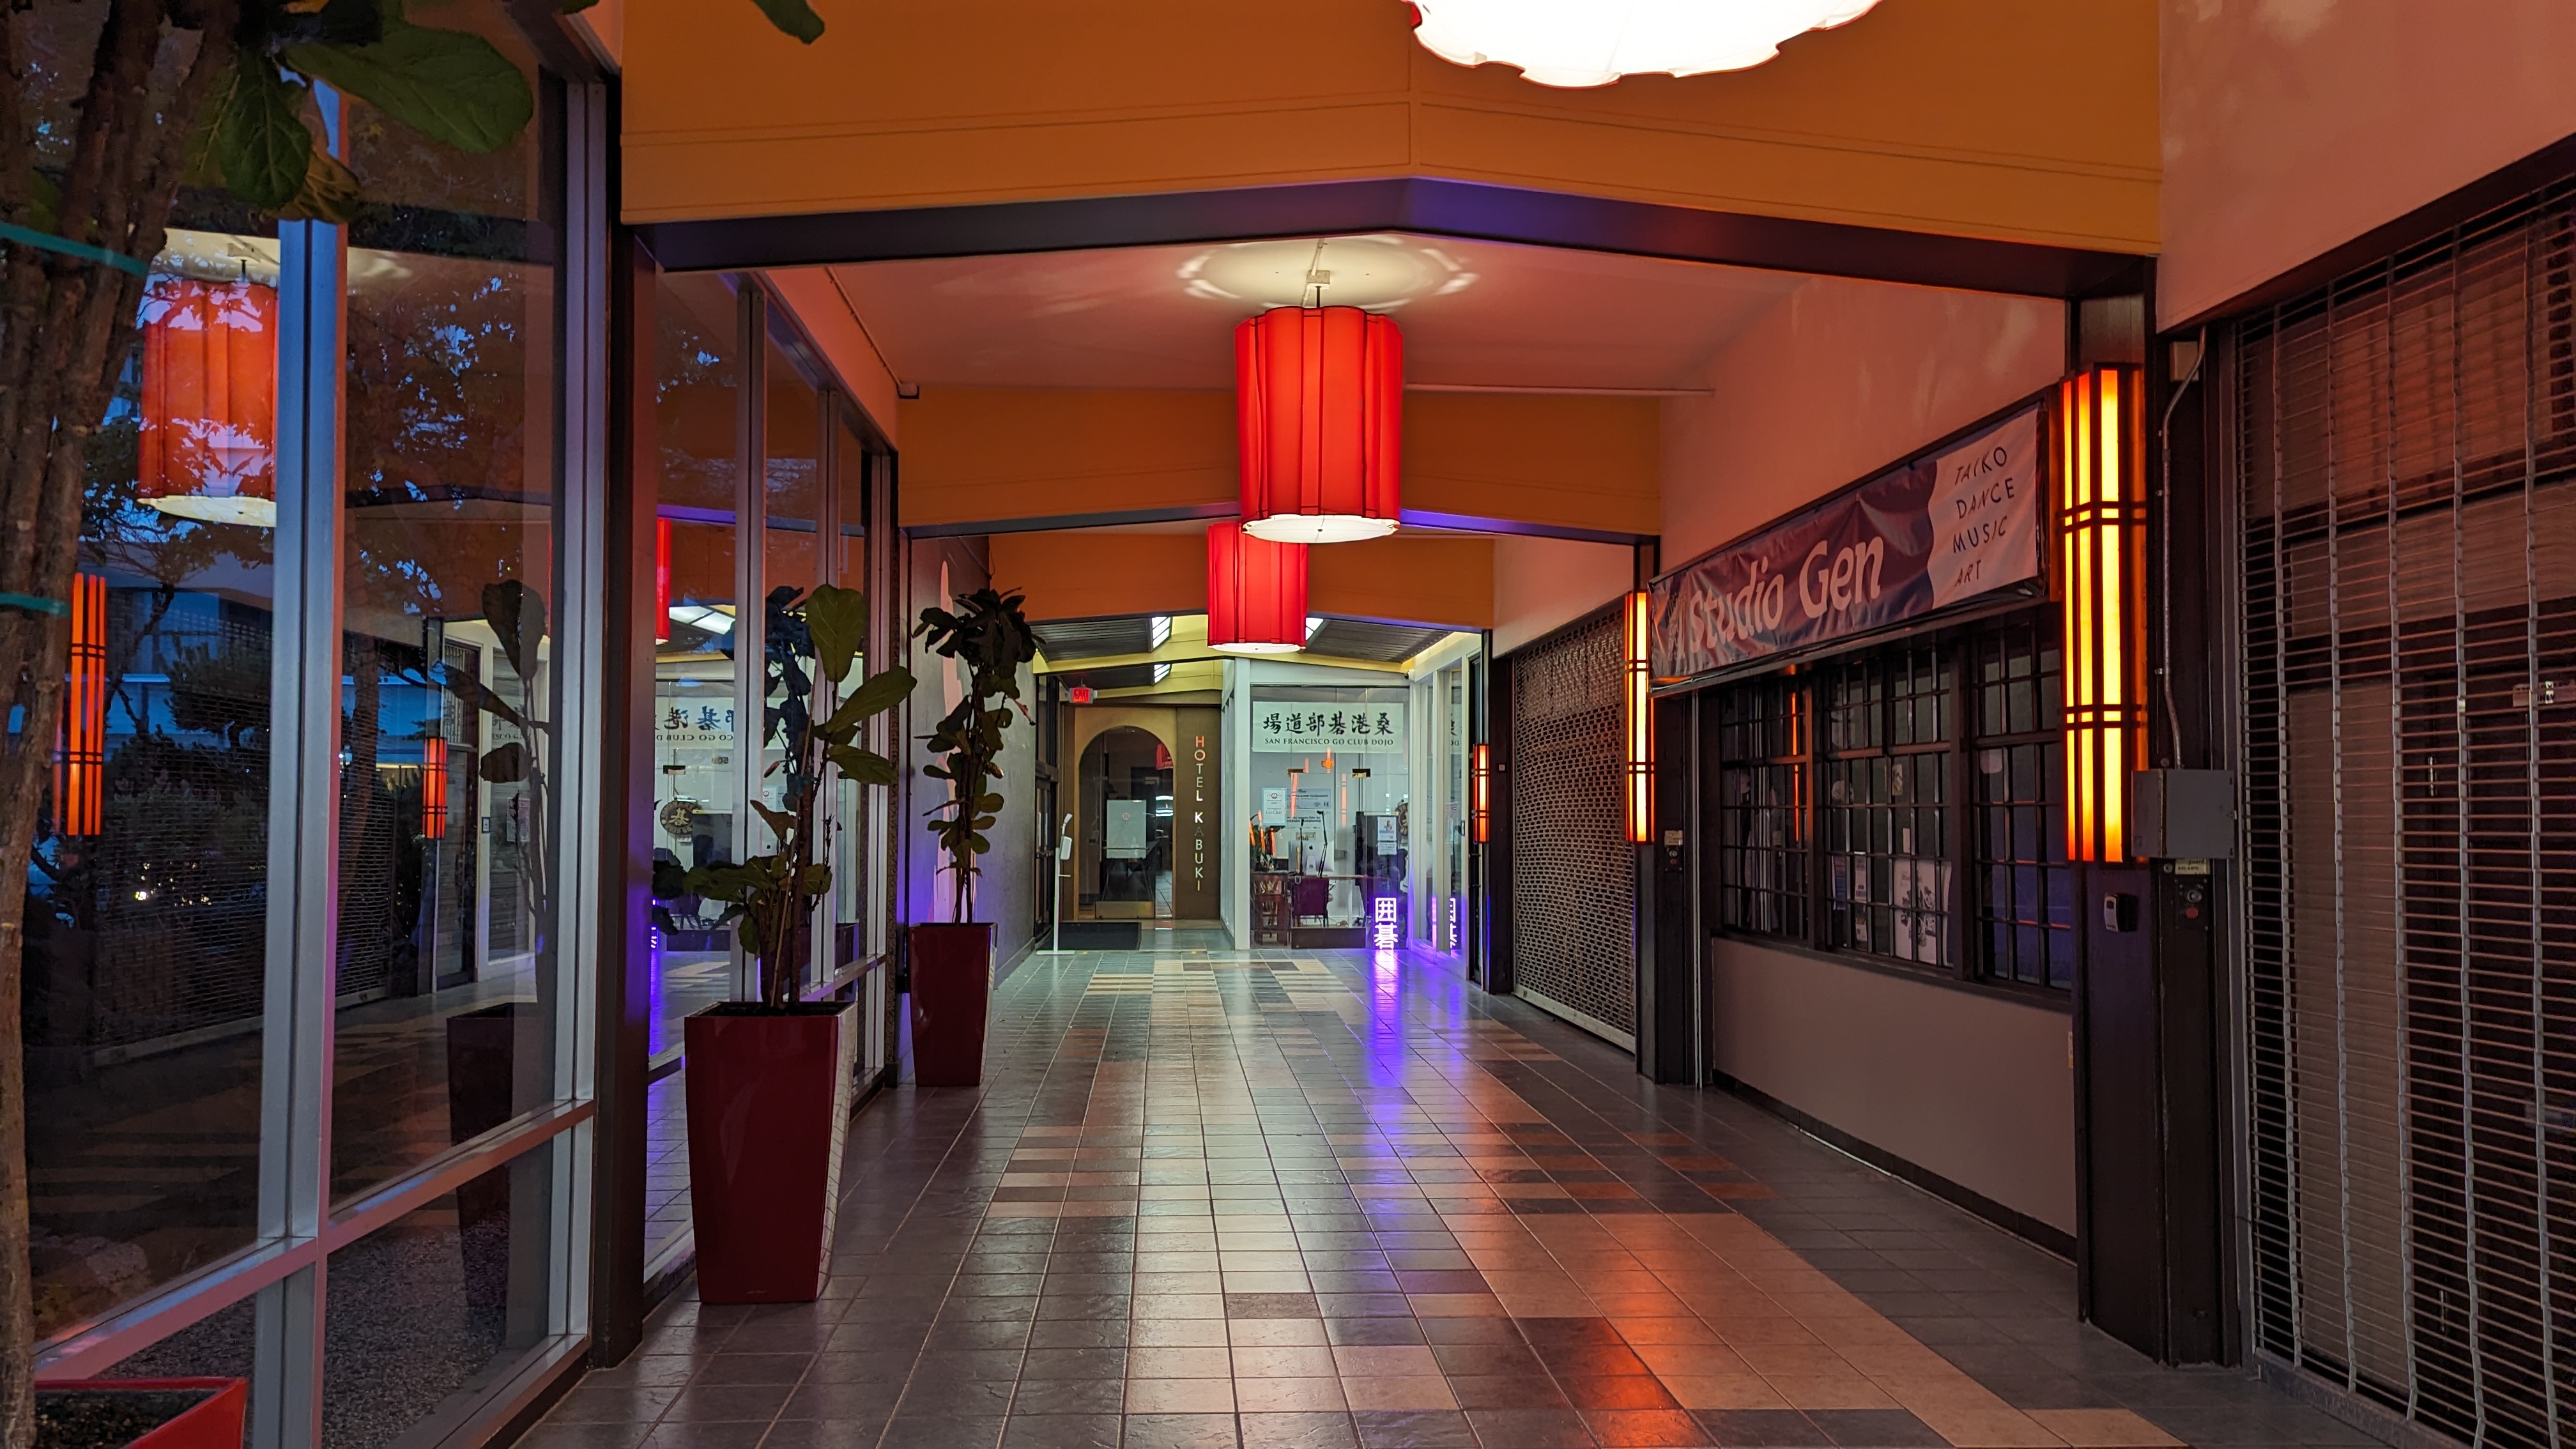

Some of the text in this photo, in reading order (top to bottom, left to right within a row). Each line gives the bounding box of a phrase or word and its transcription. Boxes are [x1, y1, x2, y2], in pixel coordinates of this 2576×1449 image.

[1955, 447, 2007, 486] TAIKO
[1956, 477, 2015, 520] DANCE
[1953, 516, 2007, 554] MUSIC
[1798, 535, 1884, 618] Gen
[1954, 560, 1982, 587] ART
[1194, 736, 1206, 891] HOTEL KABUKI
